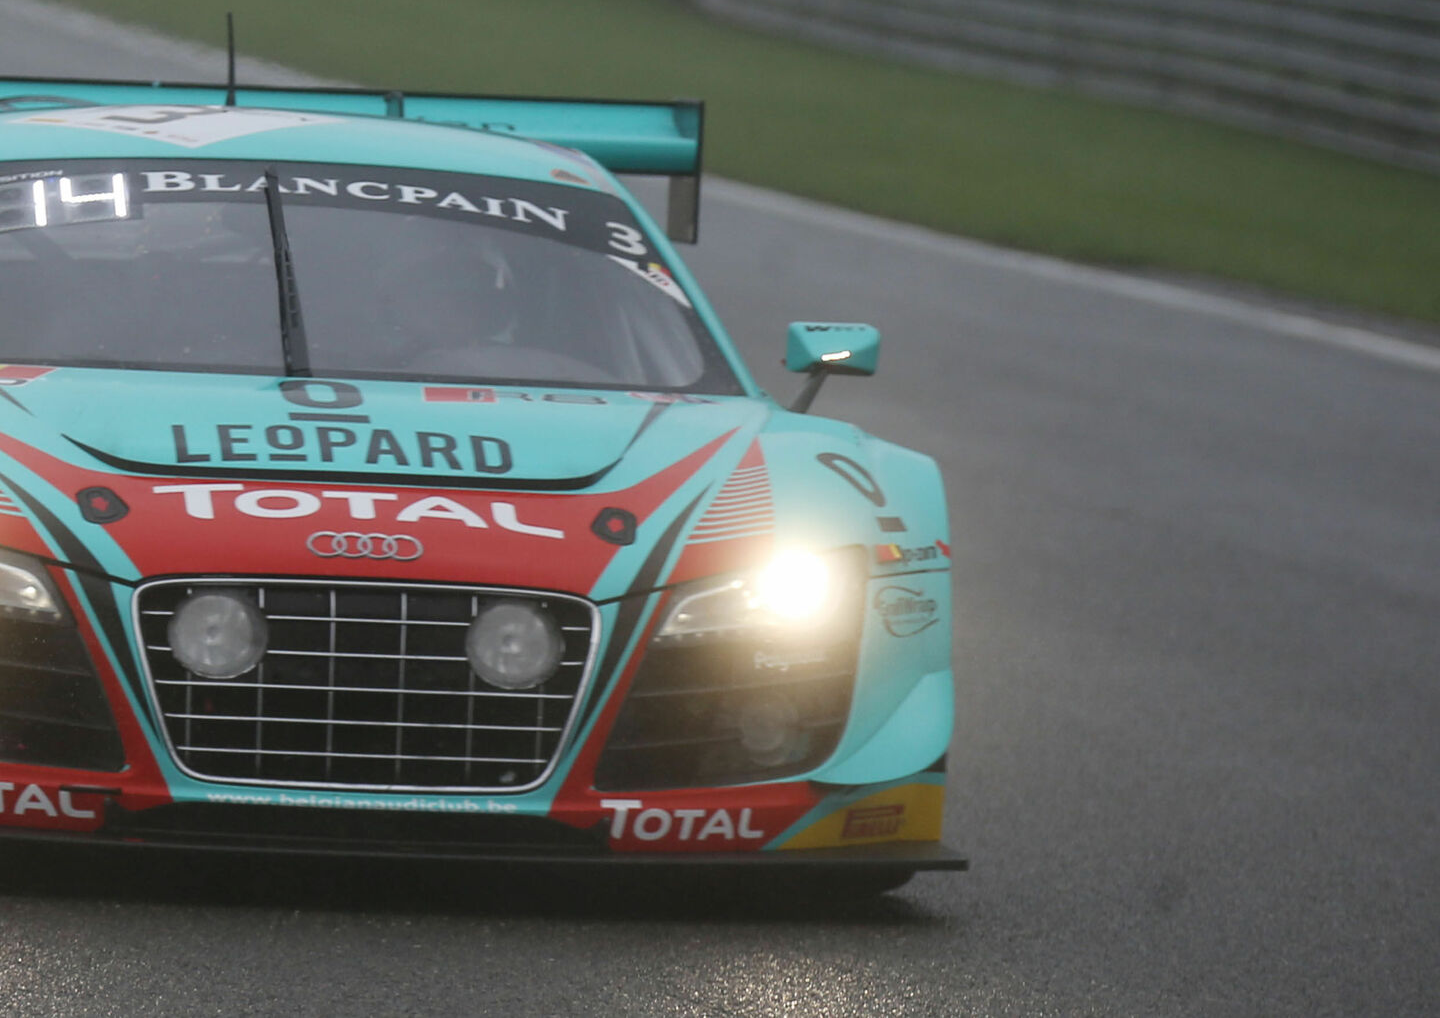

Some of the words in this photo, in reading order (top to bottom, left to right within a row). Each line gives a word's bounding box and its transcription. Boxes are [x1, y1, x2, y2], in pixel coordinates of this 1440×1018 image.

[140, 170, 568, 232] BLANCPAIN
[605, 221, 648, 255] 3
[171, 424, 514, 474] LEOPARD
[152, 483, 565, 539] TOTAL
[206, 793, 518, 814] www.belgianaudiclub.be
[600, 798, 765, 841] TOTAL
